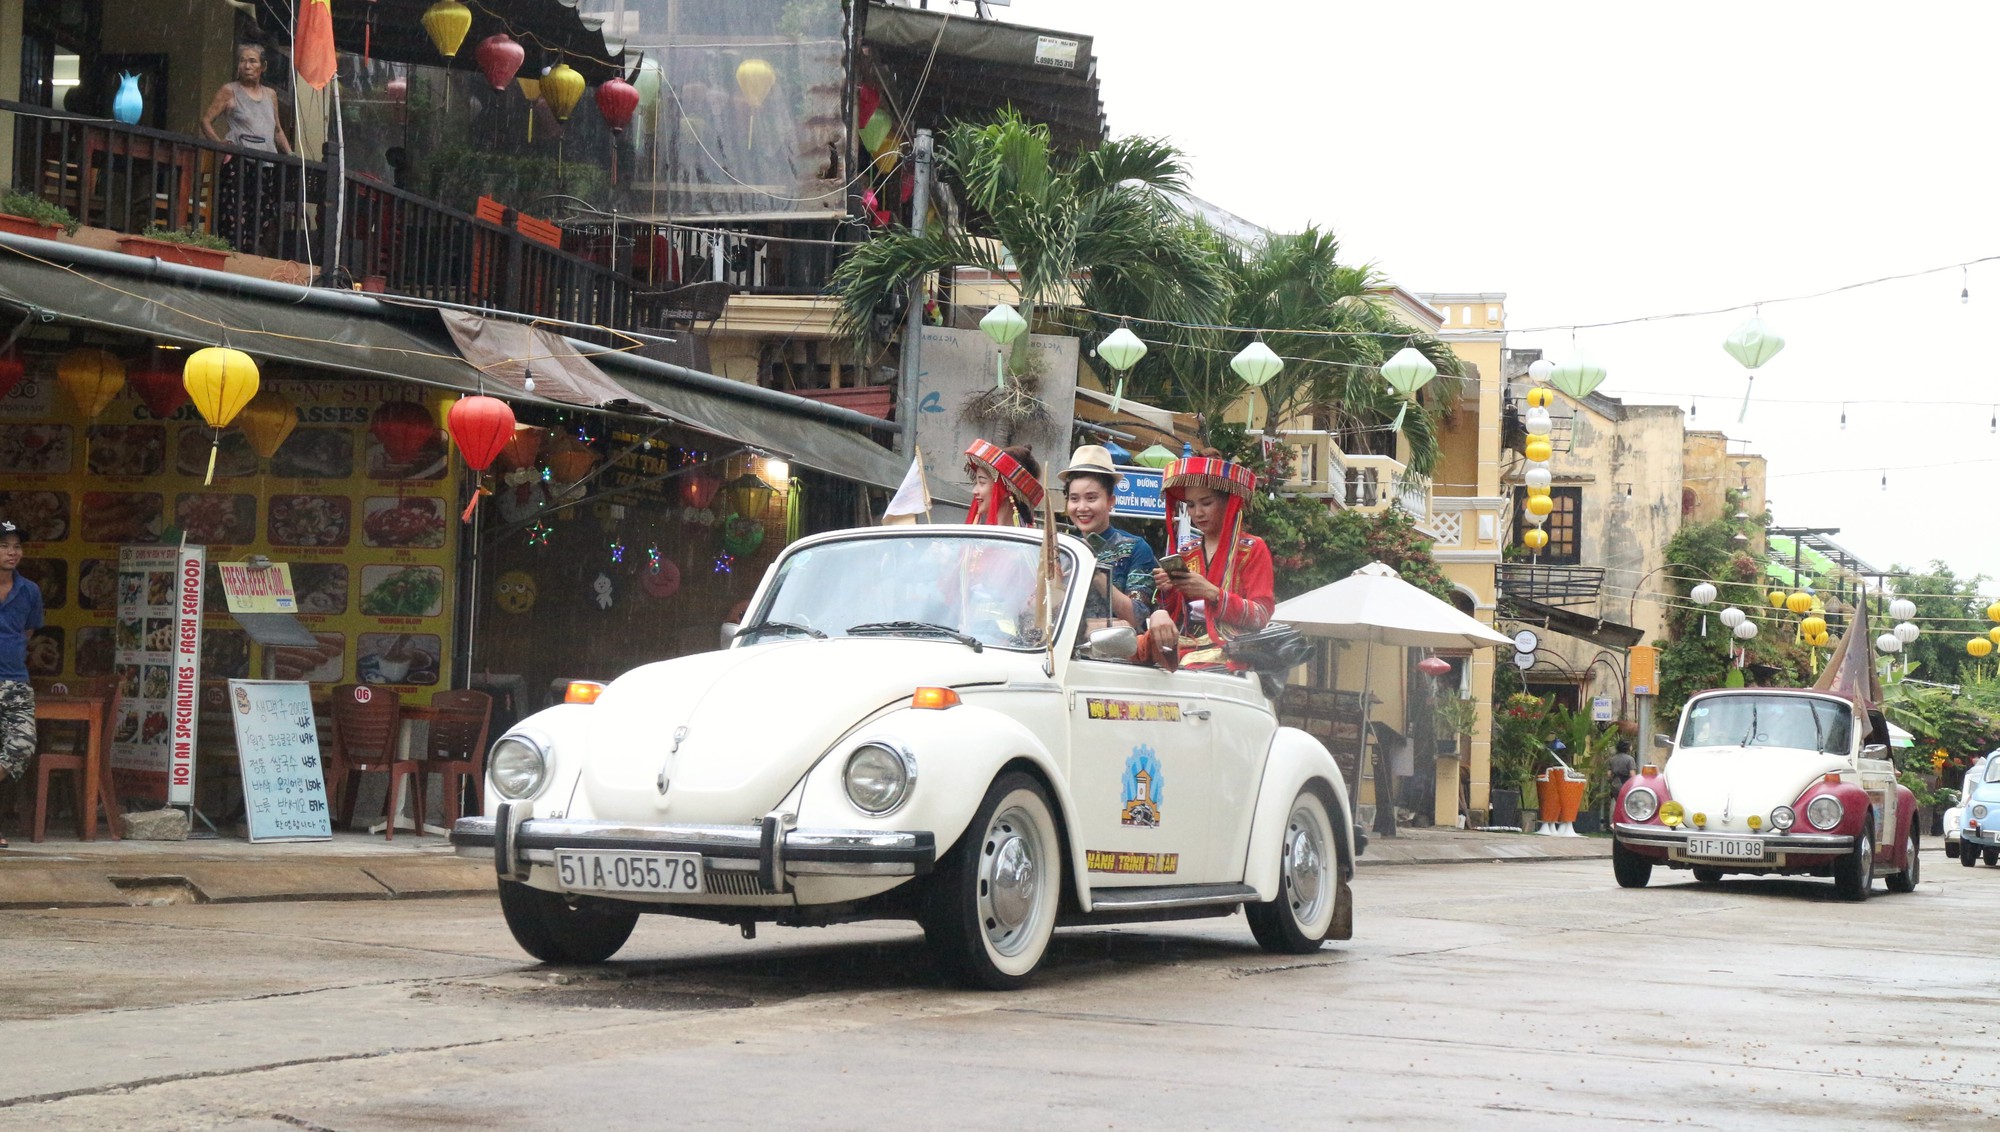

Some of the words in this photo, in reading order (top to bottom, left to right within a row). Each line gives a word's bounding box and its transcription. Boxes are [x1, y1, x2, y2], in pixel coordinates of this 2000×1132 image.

[1030, 341, 1063, 354] VICTOR
[295, 406, 369, 423] ASSES
[1140, 495, 1157, 508] PHÚC
[1157, 498, 1166, 508] CH
[183, 559, 200, 616] SEAFOOD
[221, 566, 249, 596] FRESH
[246, 567, 269, 596] BEER
[180, 619, 197, 654] FRESH
[356, 689, 370, 699] 06
[175, 666, 194, 739] SPECIALITIES
[268, 733, 298, 747] 모닝글로리
[175, 743, 190, 759] AN
[271, 754, 298, 773] 쌀국수
[173, 763, 189, 785] HOI
[252, 781, 271, 793] 바삭
[254, 797, 271, 813] 노릇
[275, 818, 316, 830] 환영합니다
[1690, 840, 1761, 856] 51F-101.98
[1087, 850, 1115, 870] HÀNH
[1119, 852, 1146, 871] TRÌNH
[560, 854, 698, 889] 51A-055.78
